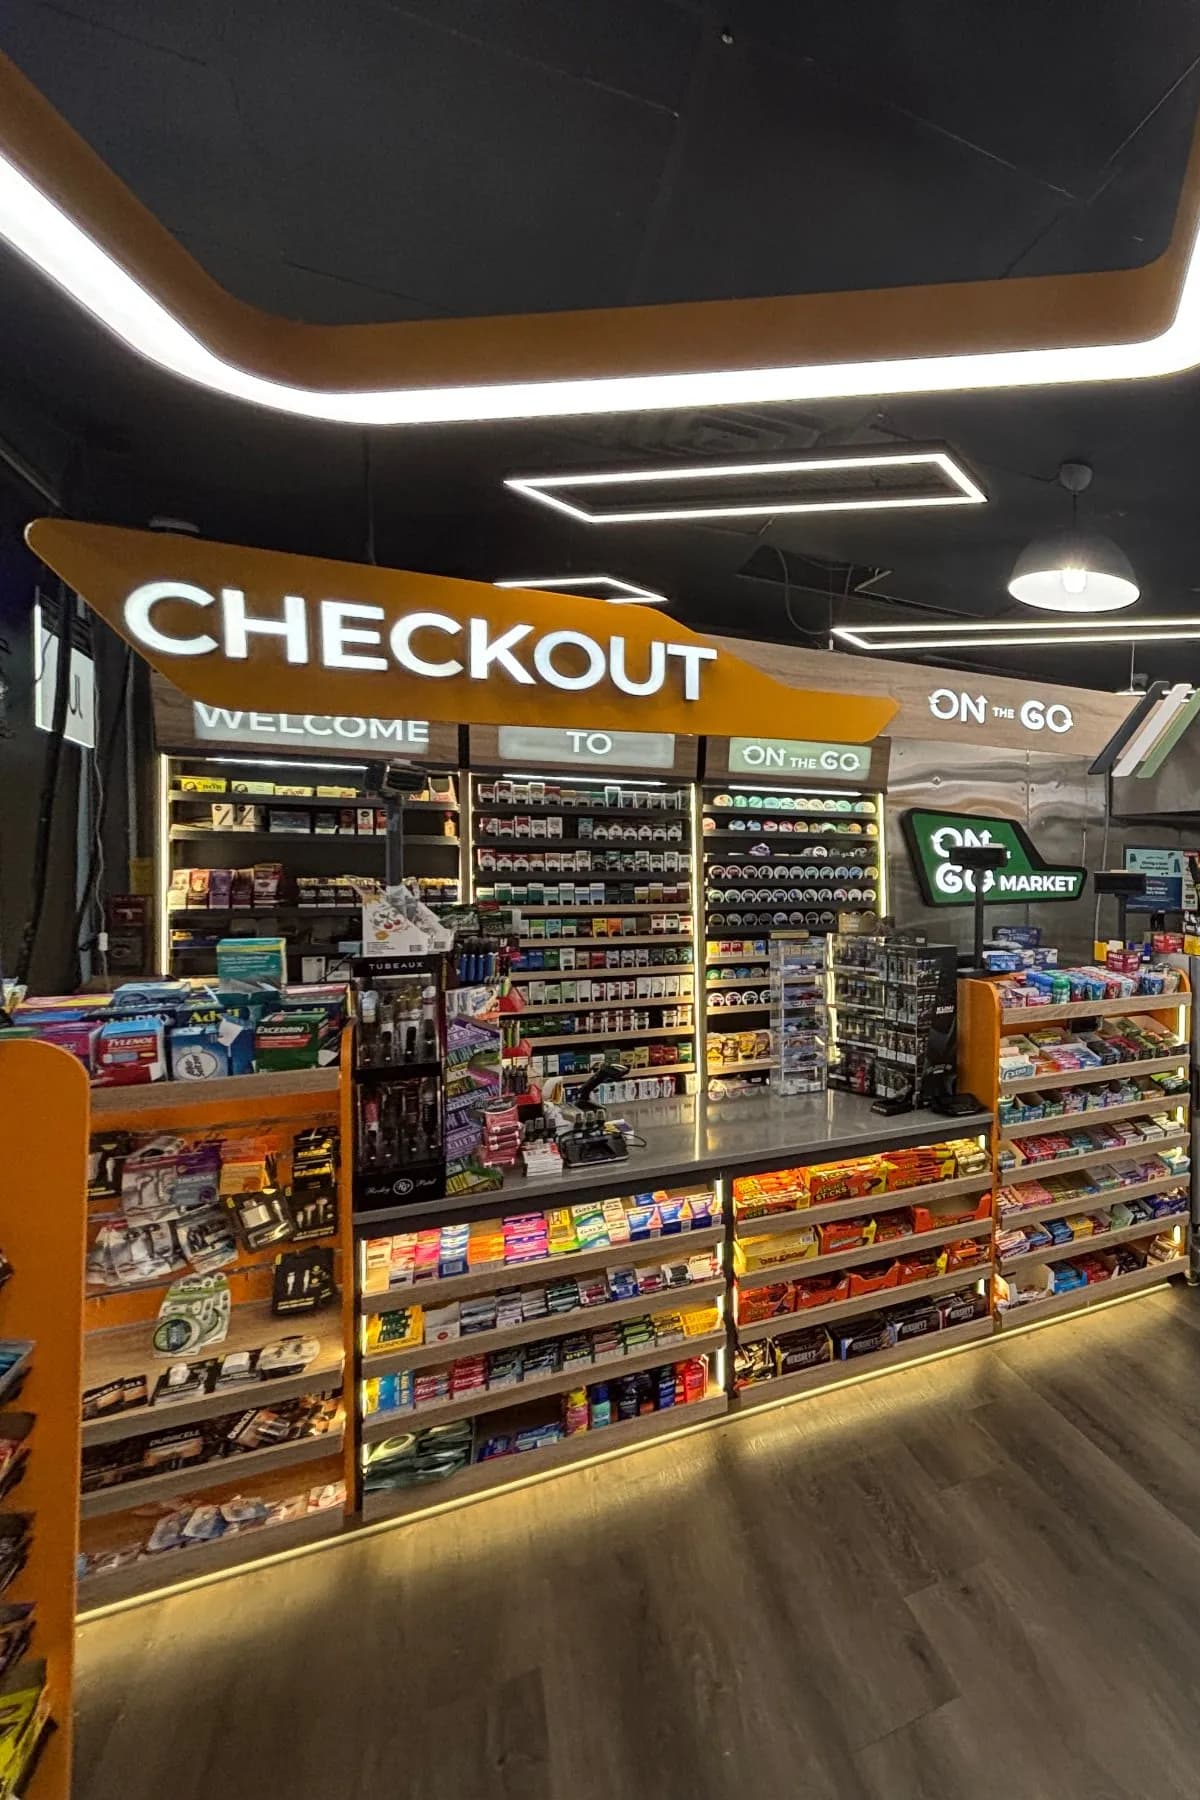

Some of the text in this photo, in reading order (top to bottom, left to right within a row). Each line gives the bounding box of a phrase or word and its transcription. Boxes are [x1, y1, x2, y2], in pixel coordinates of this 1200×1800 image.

[124, 581, 718, 702] CHECKOUT
[199, 704, 430, 744] WELCOME
[928, 688, 1074, 733] ON THE GO
[566, 731, 612, 755] TO
[742, 745, 861, 772] ON THE GO
[1000, 875, 1077, 892] MARKET
[368, 961, 424, 970] TUBEAUX
